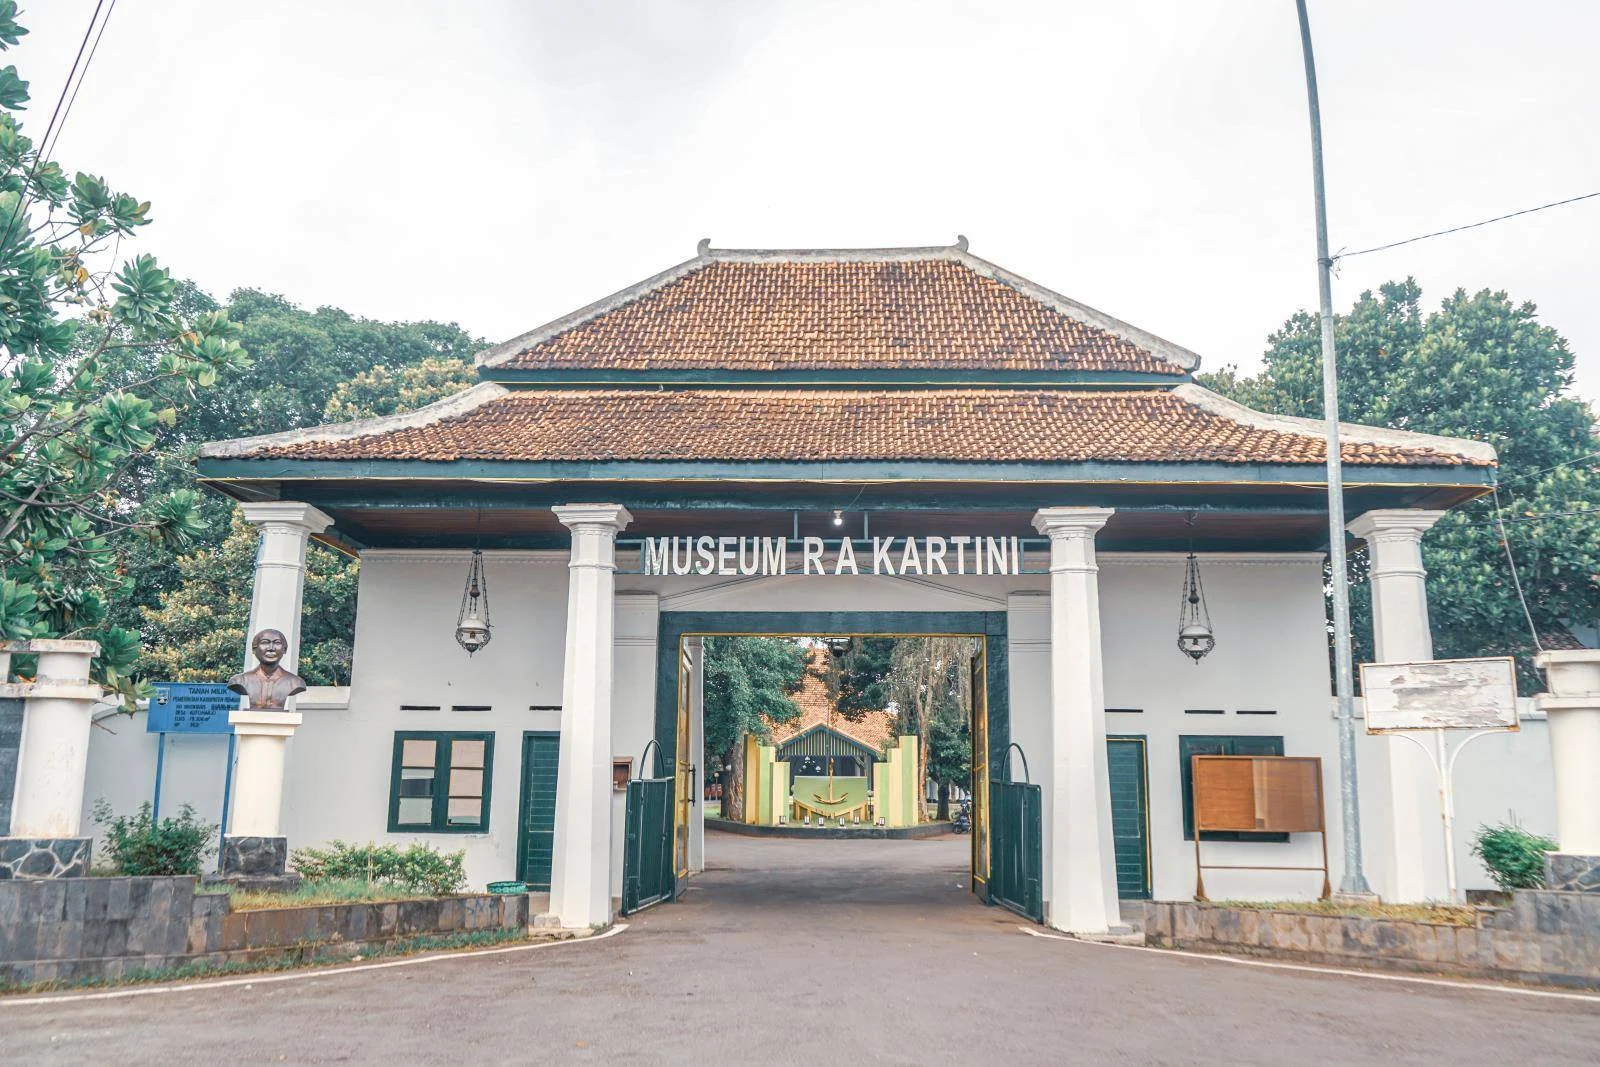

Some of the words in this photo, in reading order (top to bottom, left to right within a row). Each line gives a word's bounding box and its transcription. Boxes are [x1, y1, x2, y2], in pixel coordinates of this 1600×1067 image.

[644, 536, 787, 576] MUSEUM
[804, 536, 826, 576] R
[834, 536, 860, 576] A
[873, 536, 1020, 576] KARTINI
